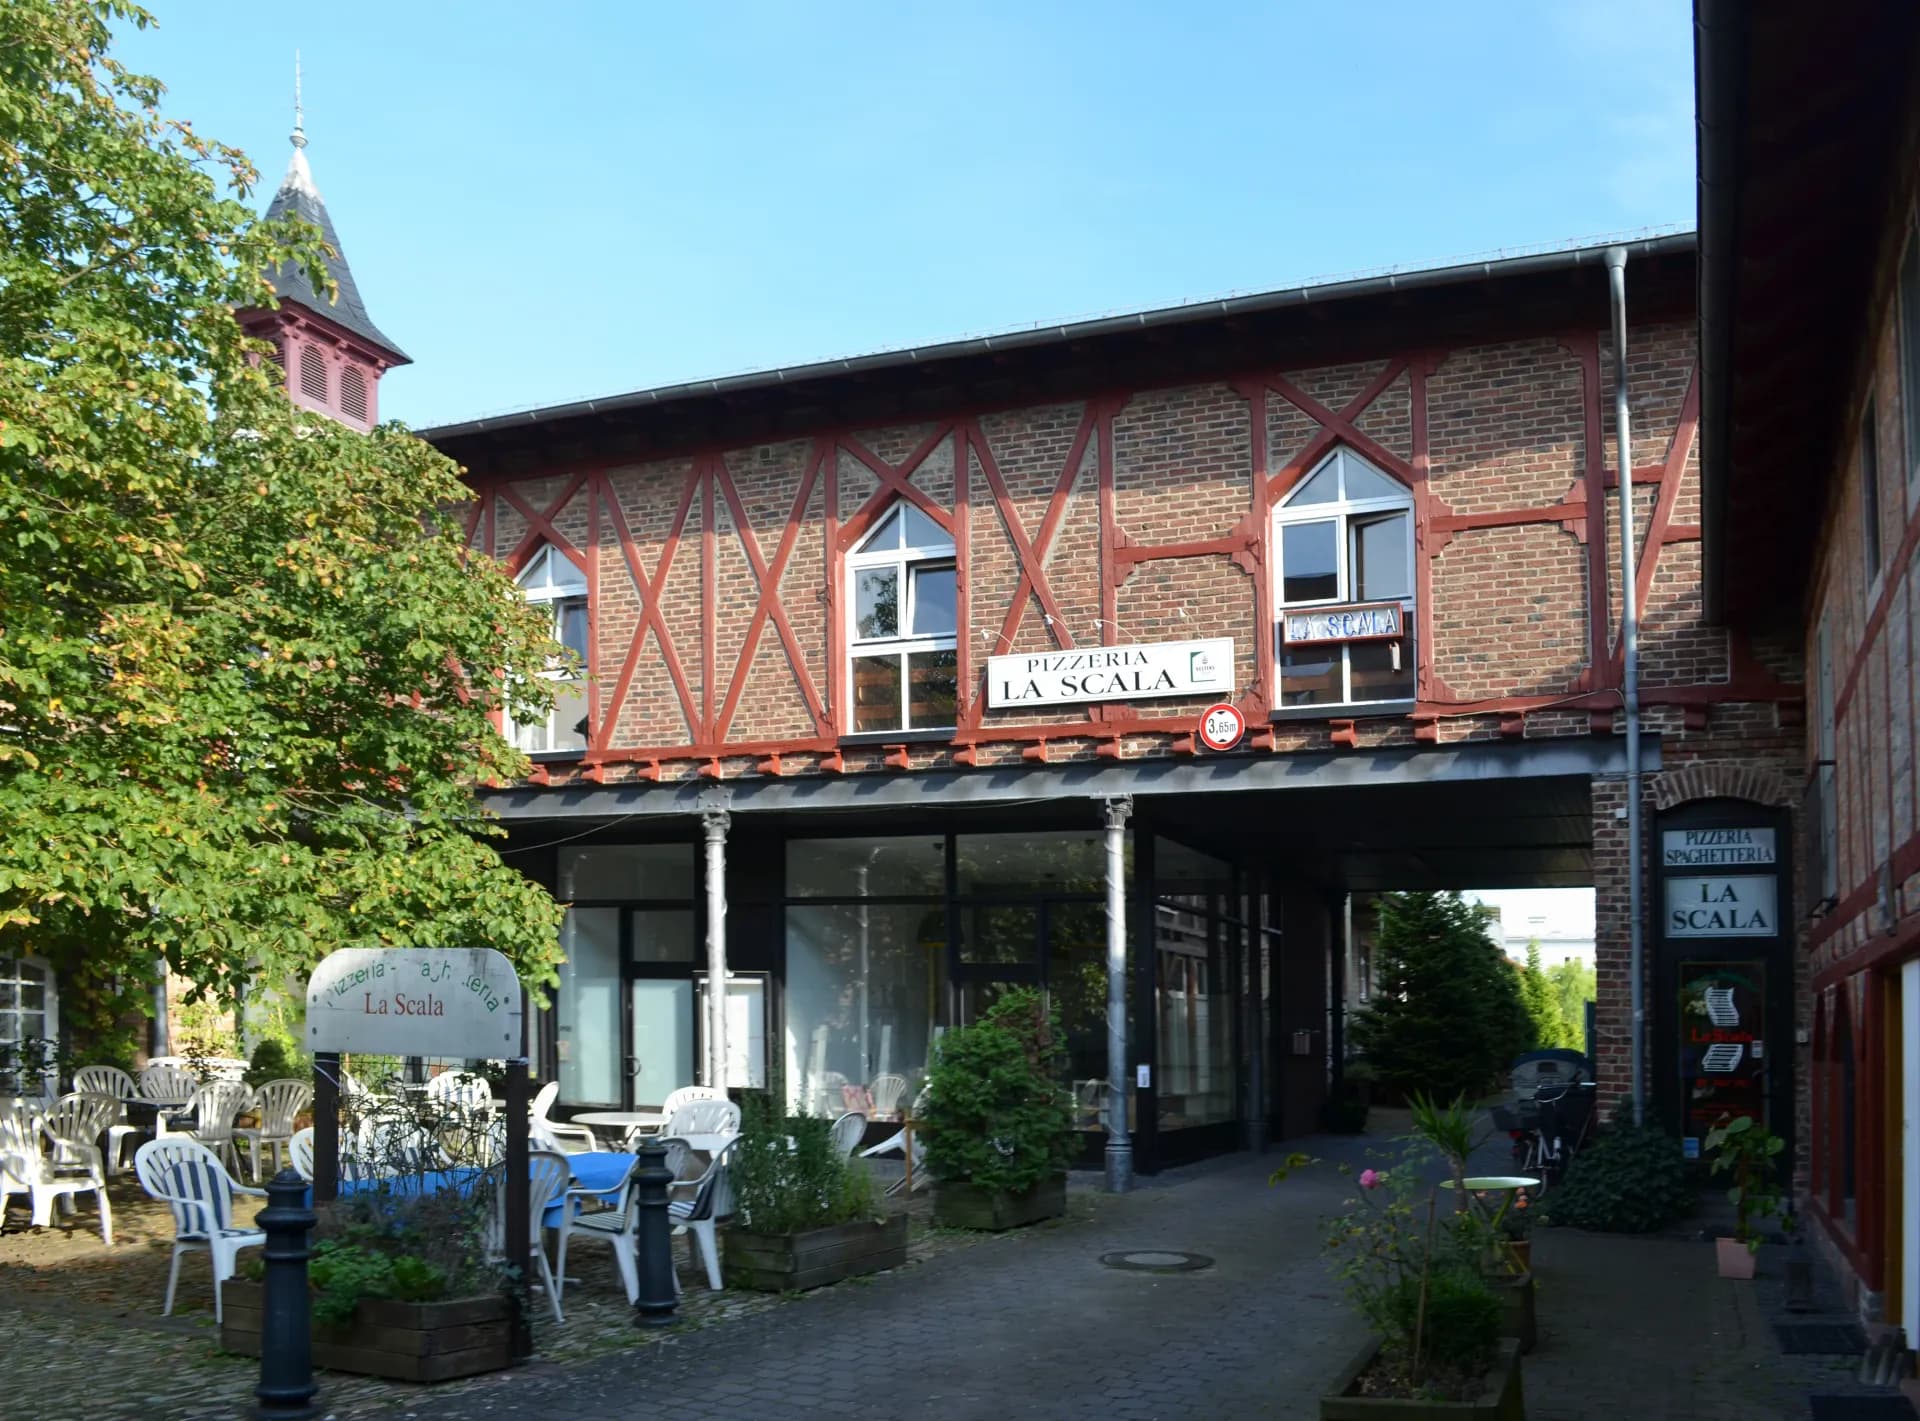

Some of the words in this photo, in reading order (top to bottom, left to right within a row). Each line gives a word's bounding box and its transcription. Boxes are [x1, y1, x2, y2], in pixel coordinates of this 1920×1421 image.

[1290, 616, 1314, 641] LA
[1327, 608, 1398, 637] SCALA
[1027, 650, 1149, 673] PIZZERIA
[1002, 678, 1045, 701] LA
[1061, 667, 1177, 698] SCALA
[1685, 829, 1753, 846] PIZZERIA
[1665, 847, 1773, 865] SPAGHETTERIA
[1701, 883, 1739, 903] LA
[1672, 908, 1769, 930] SCALA
[364, 992, 388, 1015] La
[395, 992, 444, 1016] Scala
